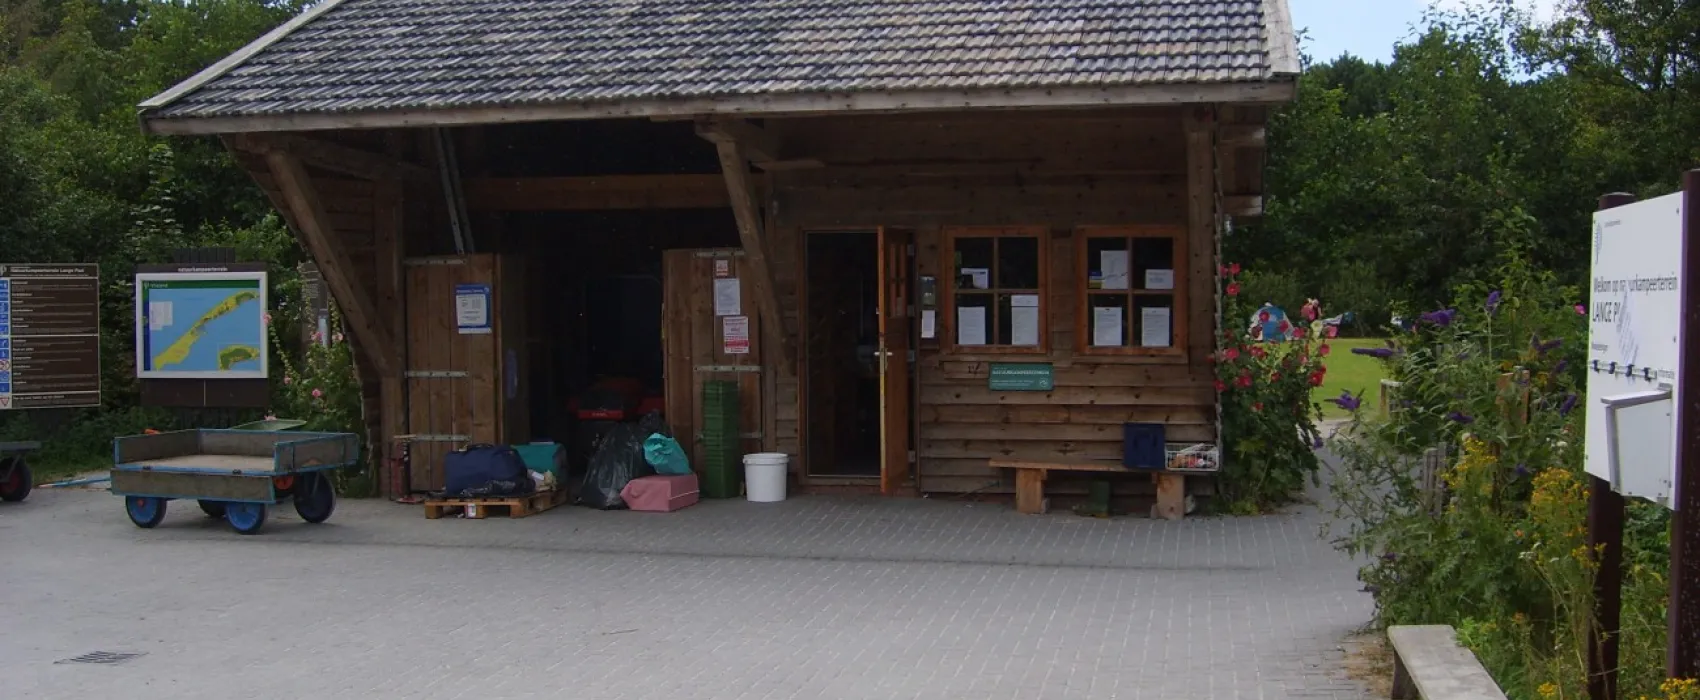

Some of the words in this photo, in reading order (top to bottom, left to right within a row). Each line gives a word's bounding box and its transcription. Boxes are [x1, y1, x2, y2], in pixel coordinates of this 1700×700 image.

[1594, 276, 1611, 292] Welkom
[1612, 280, 1619, 296] op
[1620, 272, 1677, 296] naurkampeerterrein
[1592, 302, 1611, 323] LANGE
